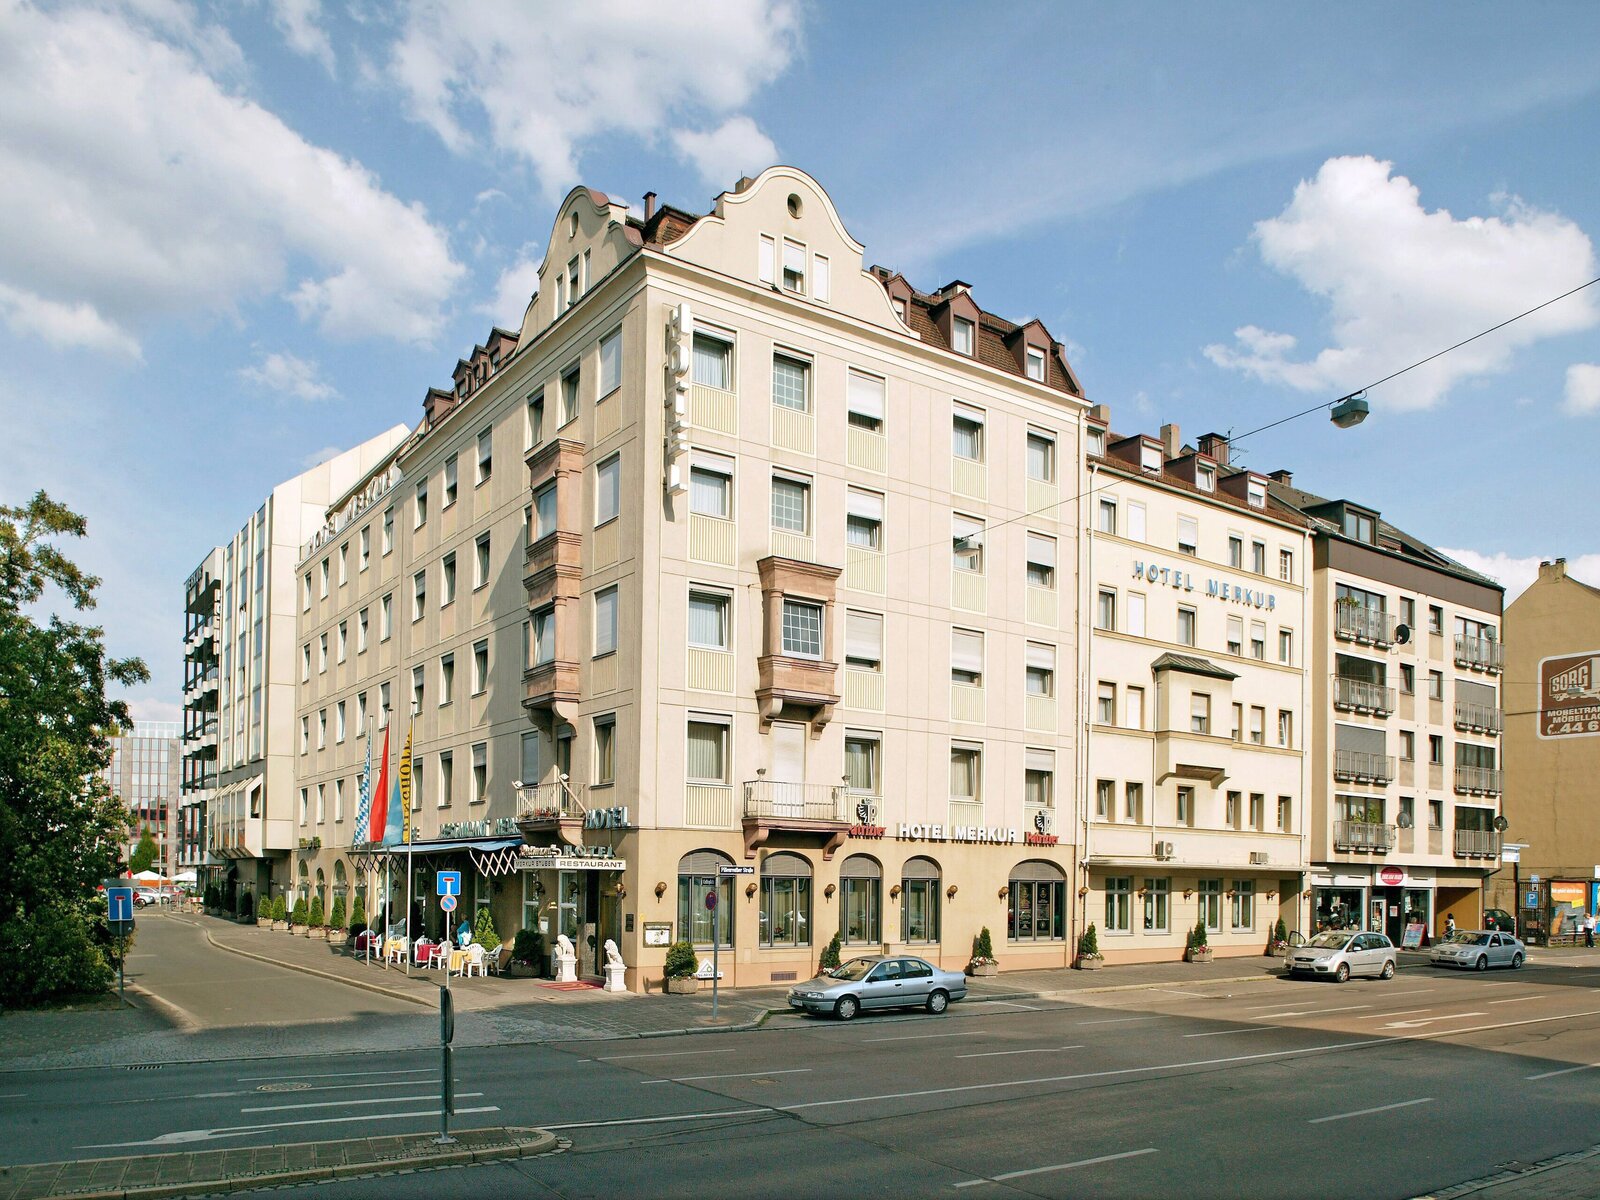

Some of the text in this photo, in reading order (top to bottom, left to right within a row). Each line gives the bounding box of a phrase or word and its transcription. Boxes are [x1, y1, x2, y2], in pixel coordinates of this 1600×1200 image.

[667, 303, 691, 496] HOTEL
[1134, 561, 1275, 609] HOTEL MERKUR
[1552, 665, 1588, 692] SORG
[585, 806, 631, 829] HOTEL
[899, 822, 1017, 843] HOTEL MERKUR
